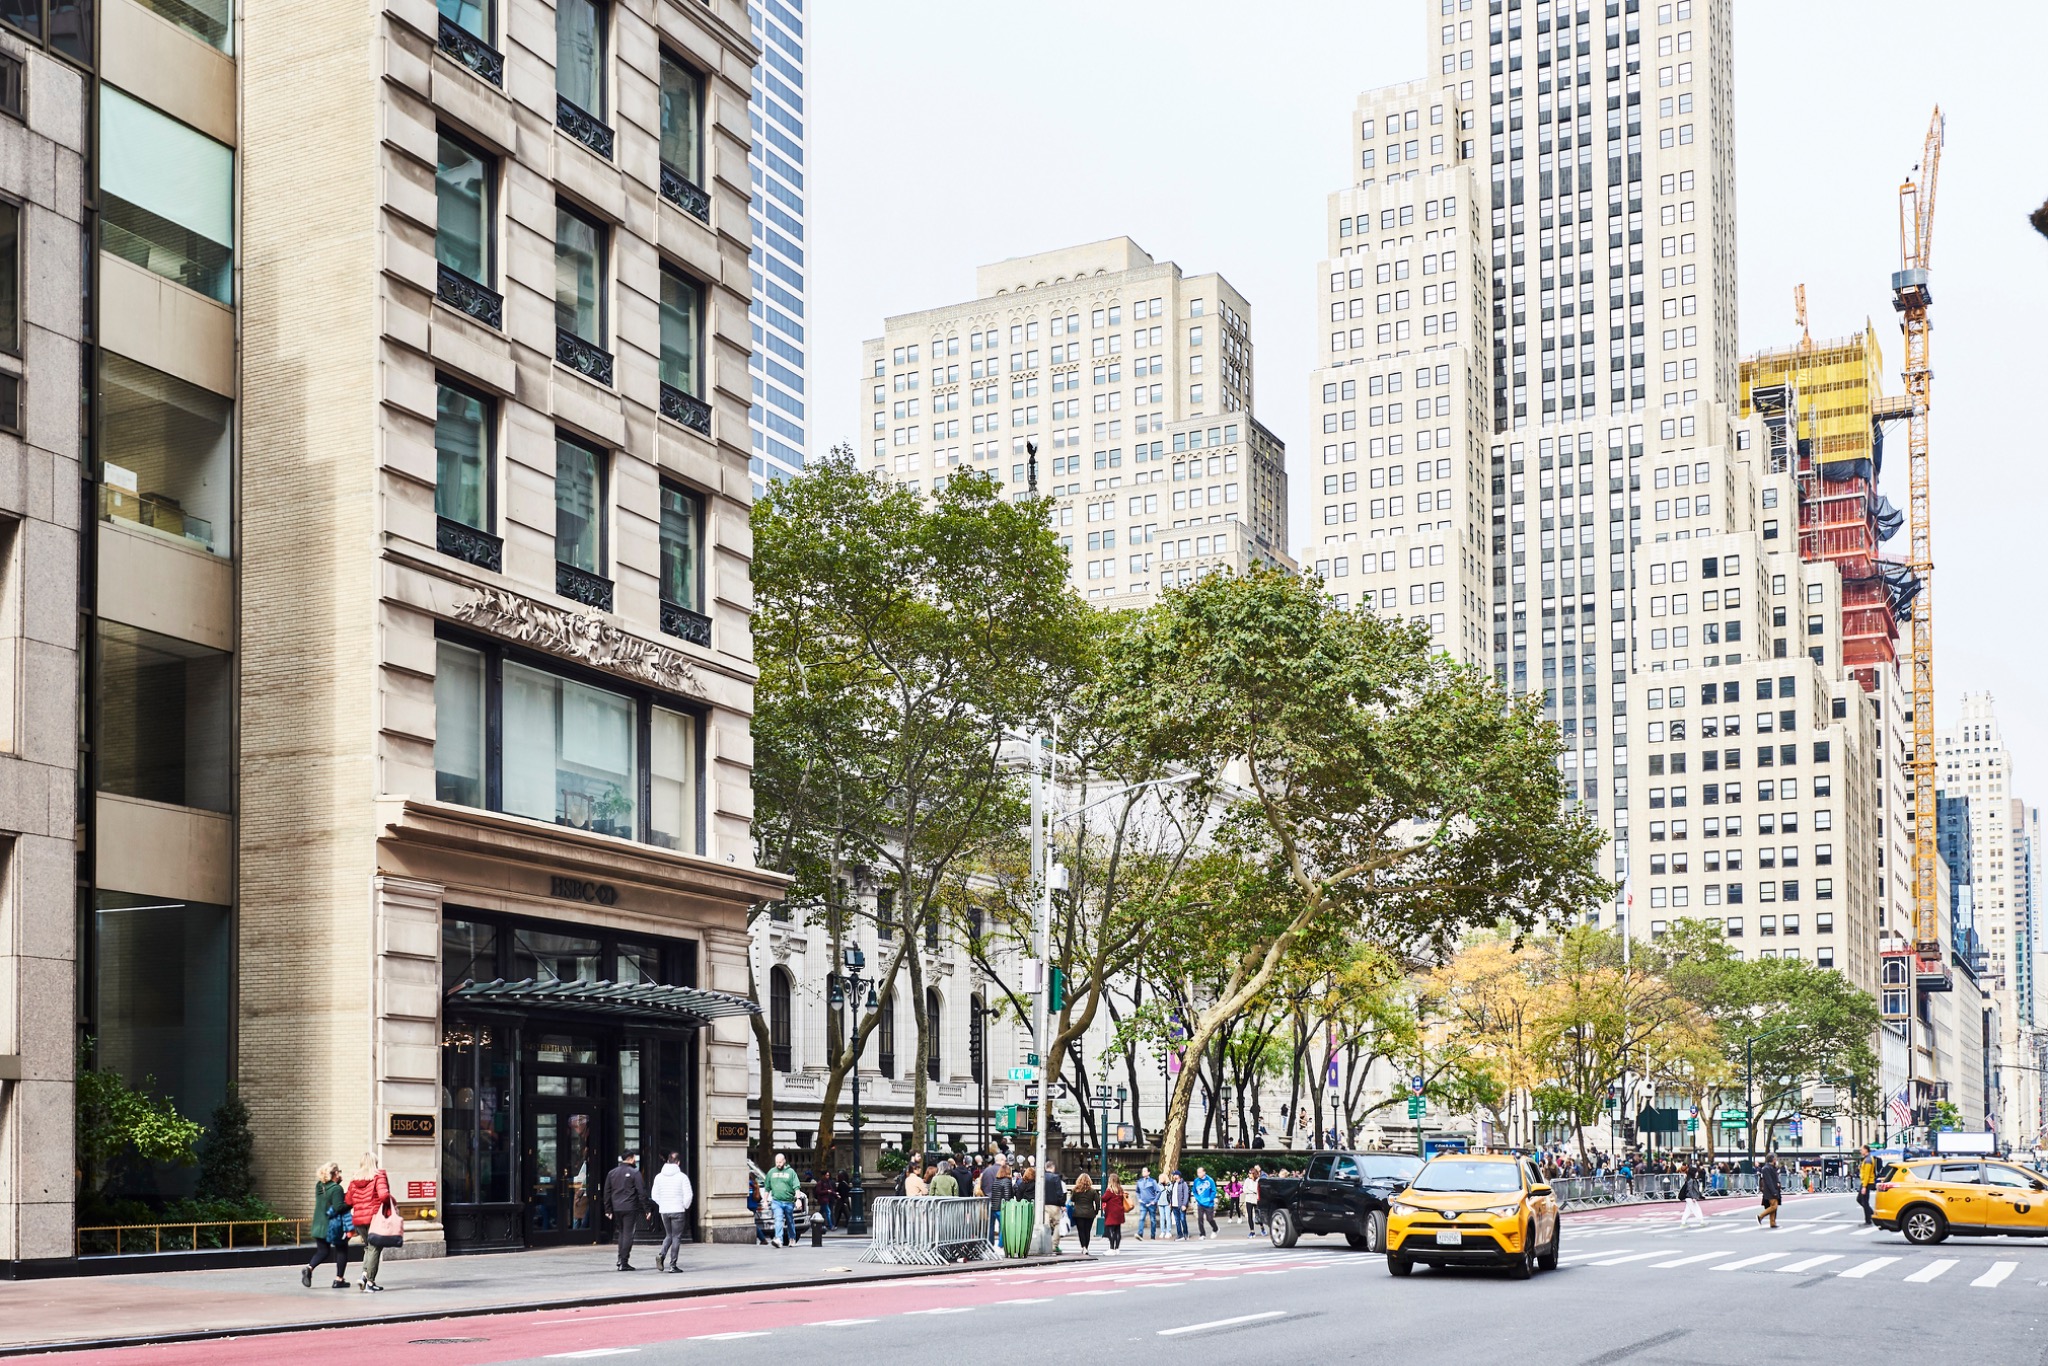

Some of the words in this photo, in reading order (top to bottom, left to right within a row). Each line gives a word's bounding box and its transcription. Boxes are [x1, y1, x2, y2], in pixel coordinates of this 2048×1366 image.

[550, 875, 595, 902] HSBC
[1009, 1068, 1015, 1079] W
[1015, 1068, 1025, 1080] 40
[392, 1119, 419, 1131] HSBC
[719, 1126, 737, 1136] HSBC
